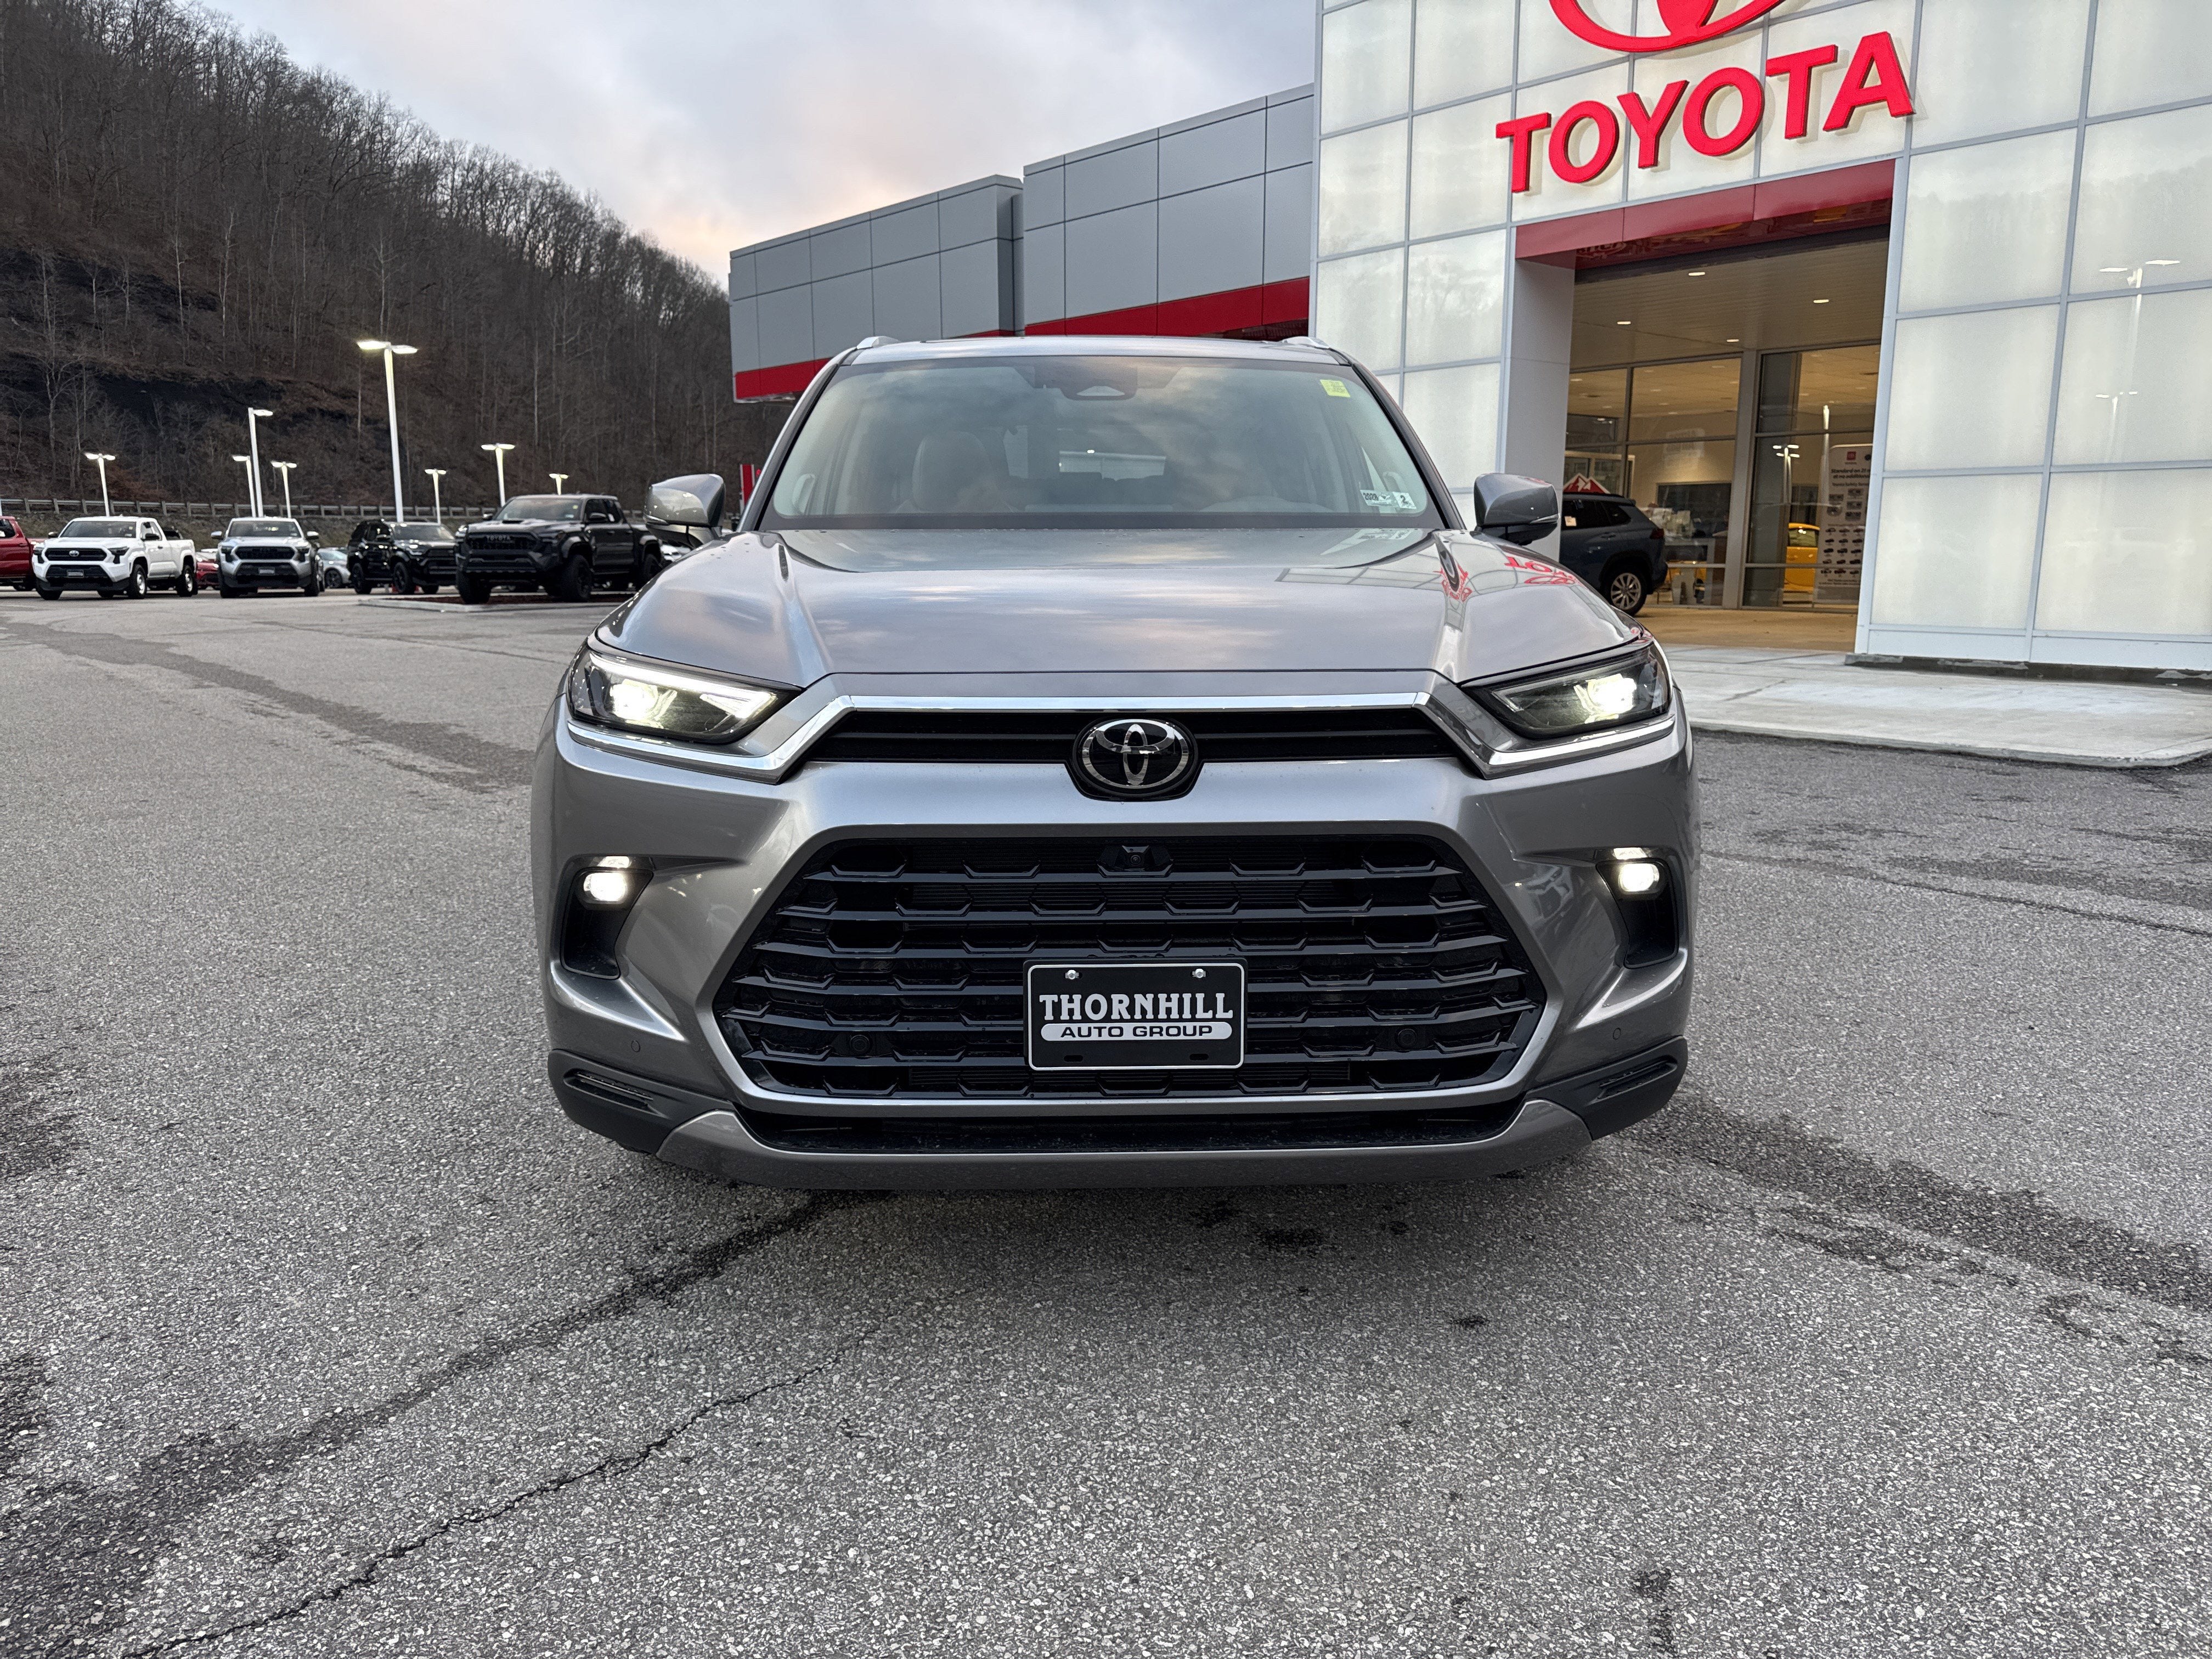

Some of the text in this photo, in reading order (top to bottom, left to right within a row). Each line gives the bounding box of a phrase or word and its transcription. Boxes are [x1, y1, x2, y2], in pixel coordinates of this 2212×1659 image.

[1496, 31, 1915, 193] TOYOTA
[1400, 495, 1409, 505] 2
[1039, 992, 1233, 1020] THORNHILL
[1060, 1025, 1212, 1038] AUTO GROUP
